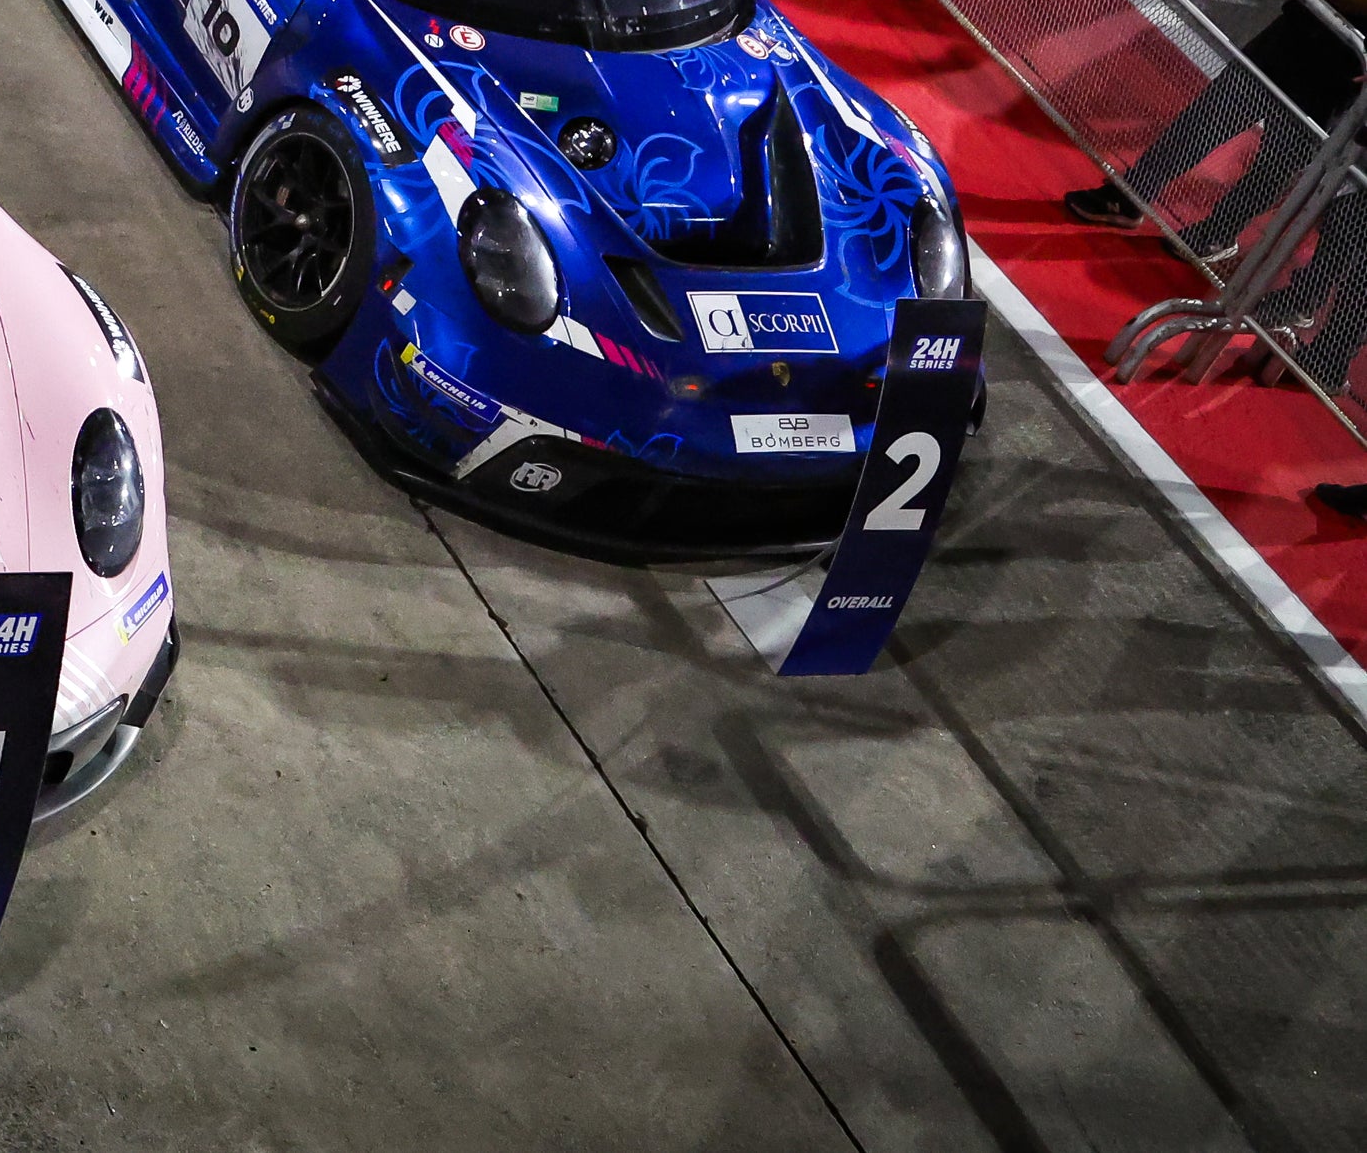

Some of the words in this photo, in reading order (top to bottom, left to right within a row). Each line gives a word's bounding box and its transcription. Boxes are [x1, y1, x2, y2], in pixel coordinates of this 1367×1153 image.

[350, 90, 402, 154] WINHERE
[747, 313, 826, 334] SCORPII
[912, 337, 961, 360] 24H
[909, 359, 954, 370] SERIES
[425, 369, 487, 411] MICHELIN
[750, 435, 842, 448] BOMBERG
[862, 431, 942, 531] 2
[133, 582, 164, 623] MICHELIN
[827, 596, 894, 609] OVERALL
